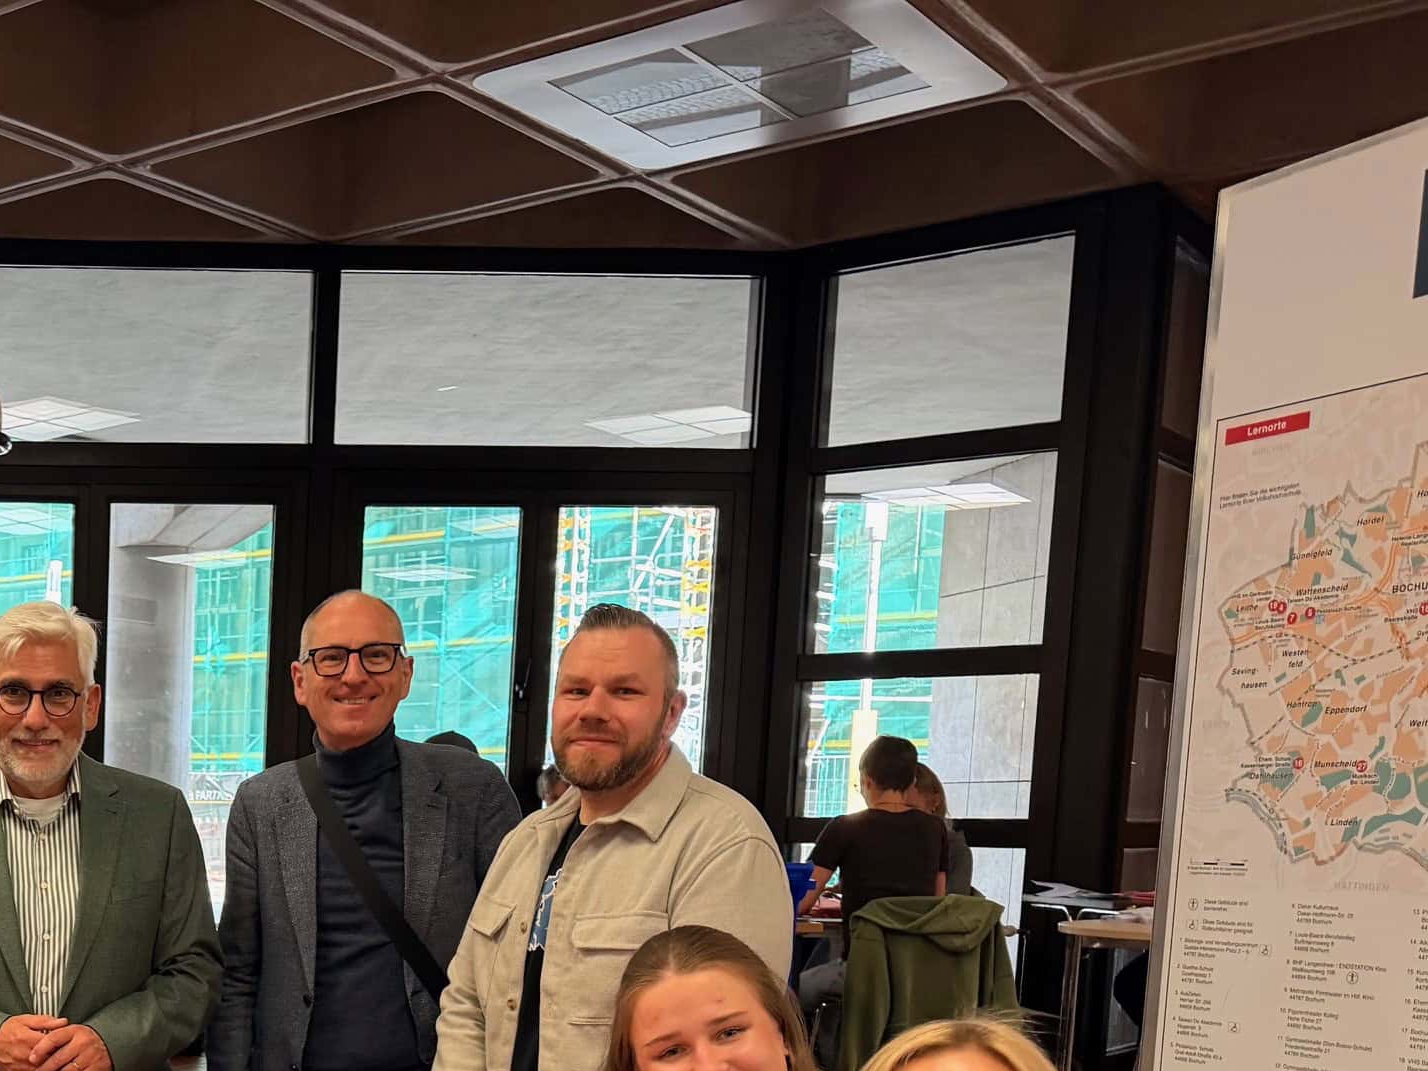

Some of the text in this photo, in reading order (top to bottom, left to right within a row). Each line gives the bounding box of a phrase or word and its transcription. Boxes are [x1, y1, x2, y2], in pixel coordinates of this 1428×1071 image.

[1246, 421, 1287, 436] Lernorte
[1296, 584, 1349, 597] Wattenscheid
[1325, 705, 1367, 715] Eppendorf
[1314, 759, 1357, 768] Munscheid
[1330, 818, 1358, 826] Linden
